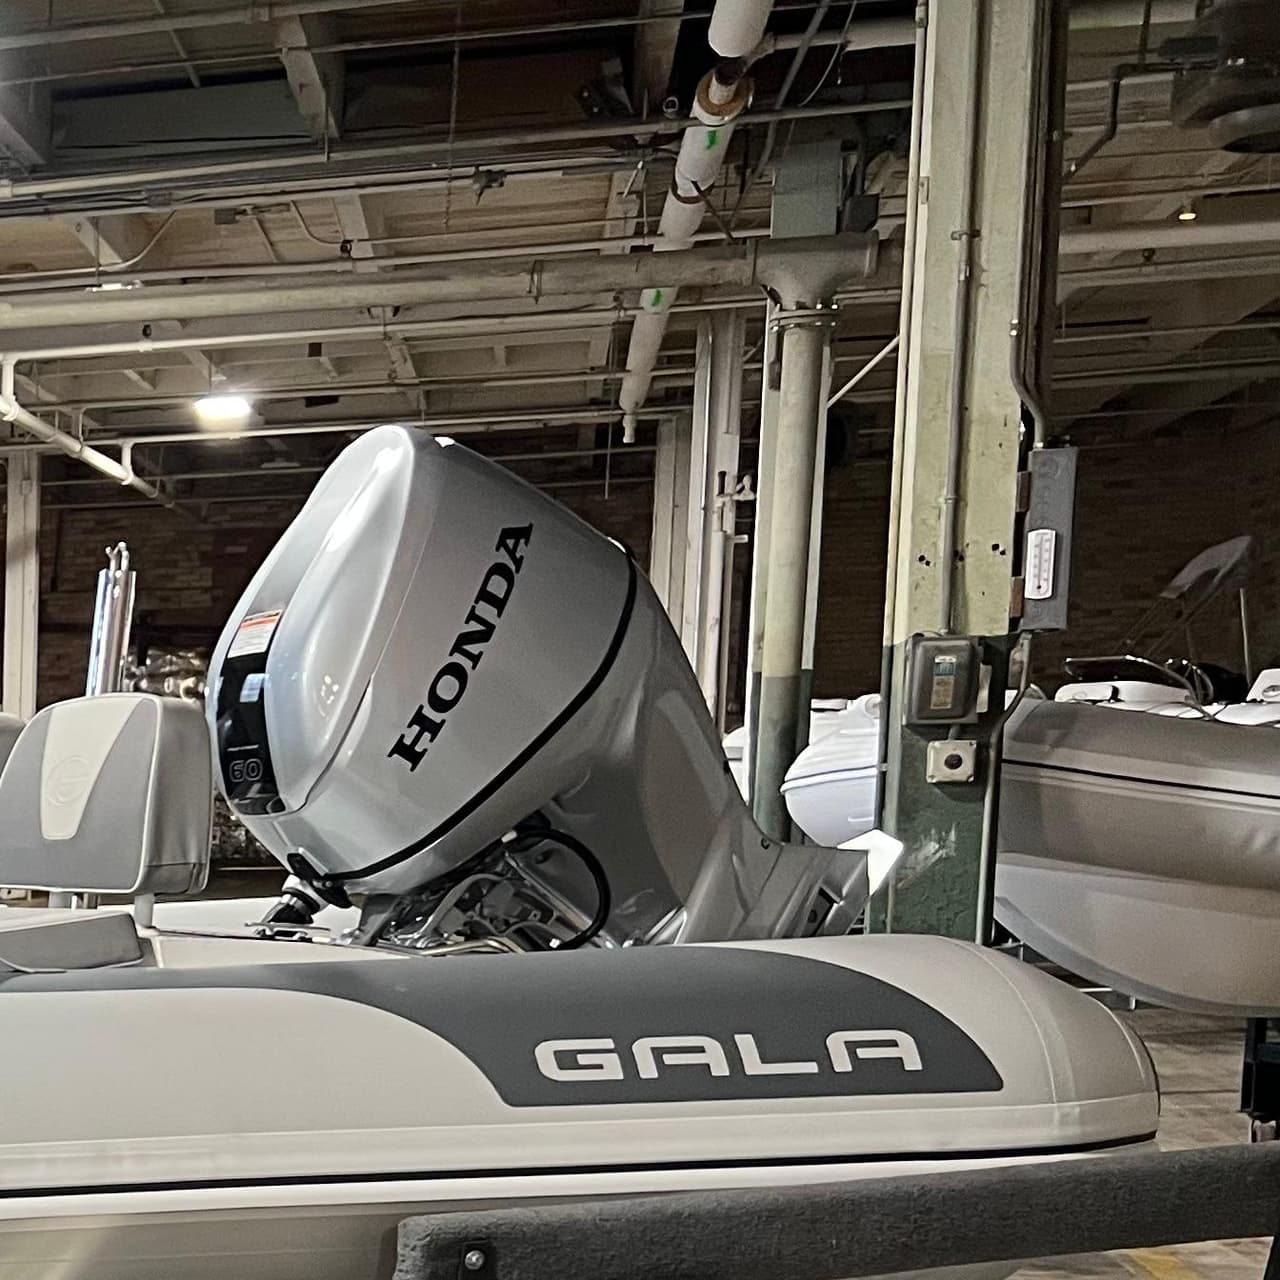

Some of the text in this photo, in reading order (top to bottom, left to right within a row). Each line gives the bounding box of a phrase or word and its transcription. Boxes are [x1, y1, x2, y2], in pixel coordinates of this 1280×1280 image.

[387, 522, 534, 772] HONDA
[229, 758, 263, 782] 60
[534, 1029, 923, 1082] GALA
